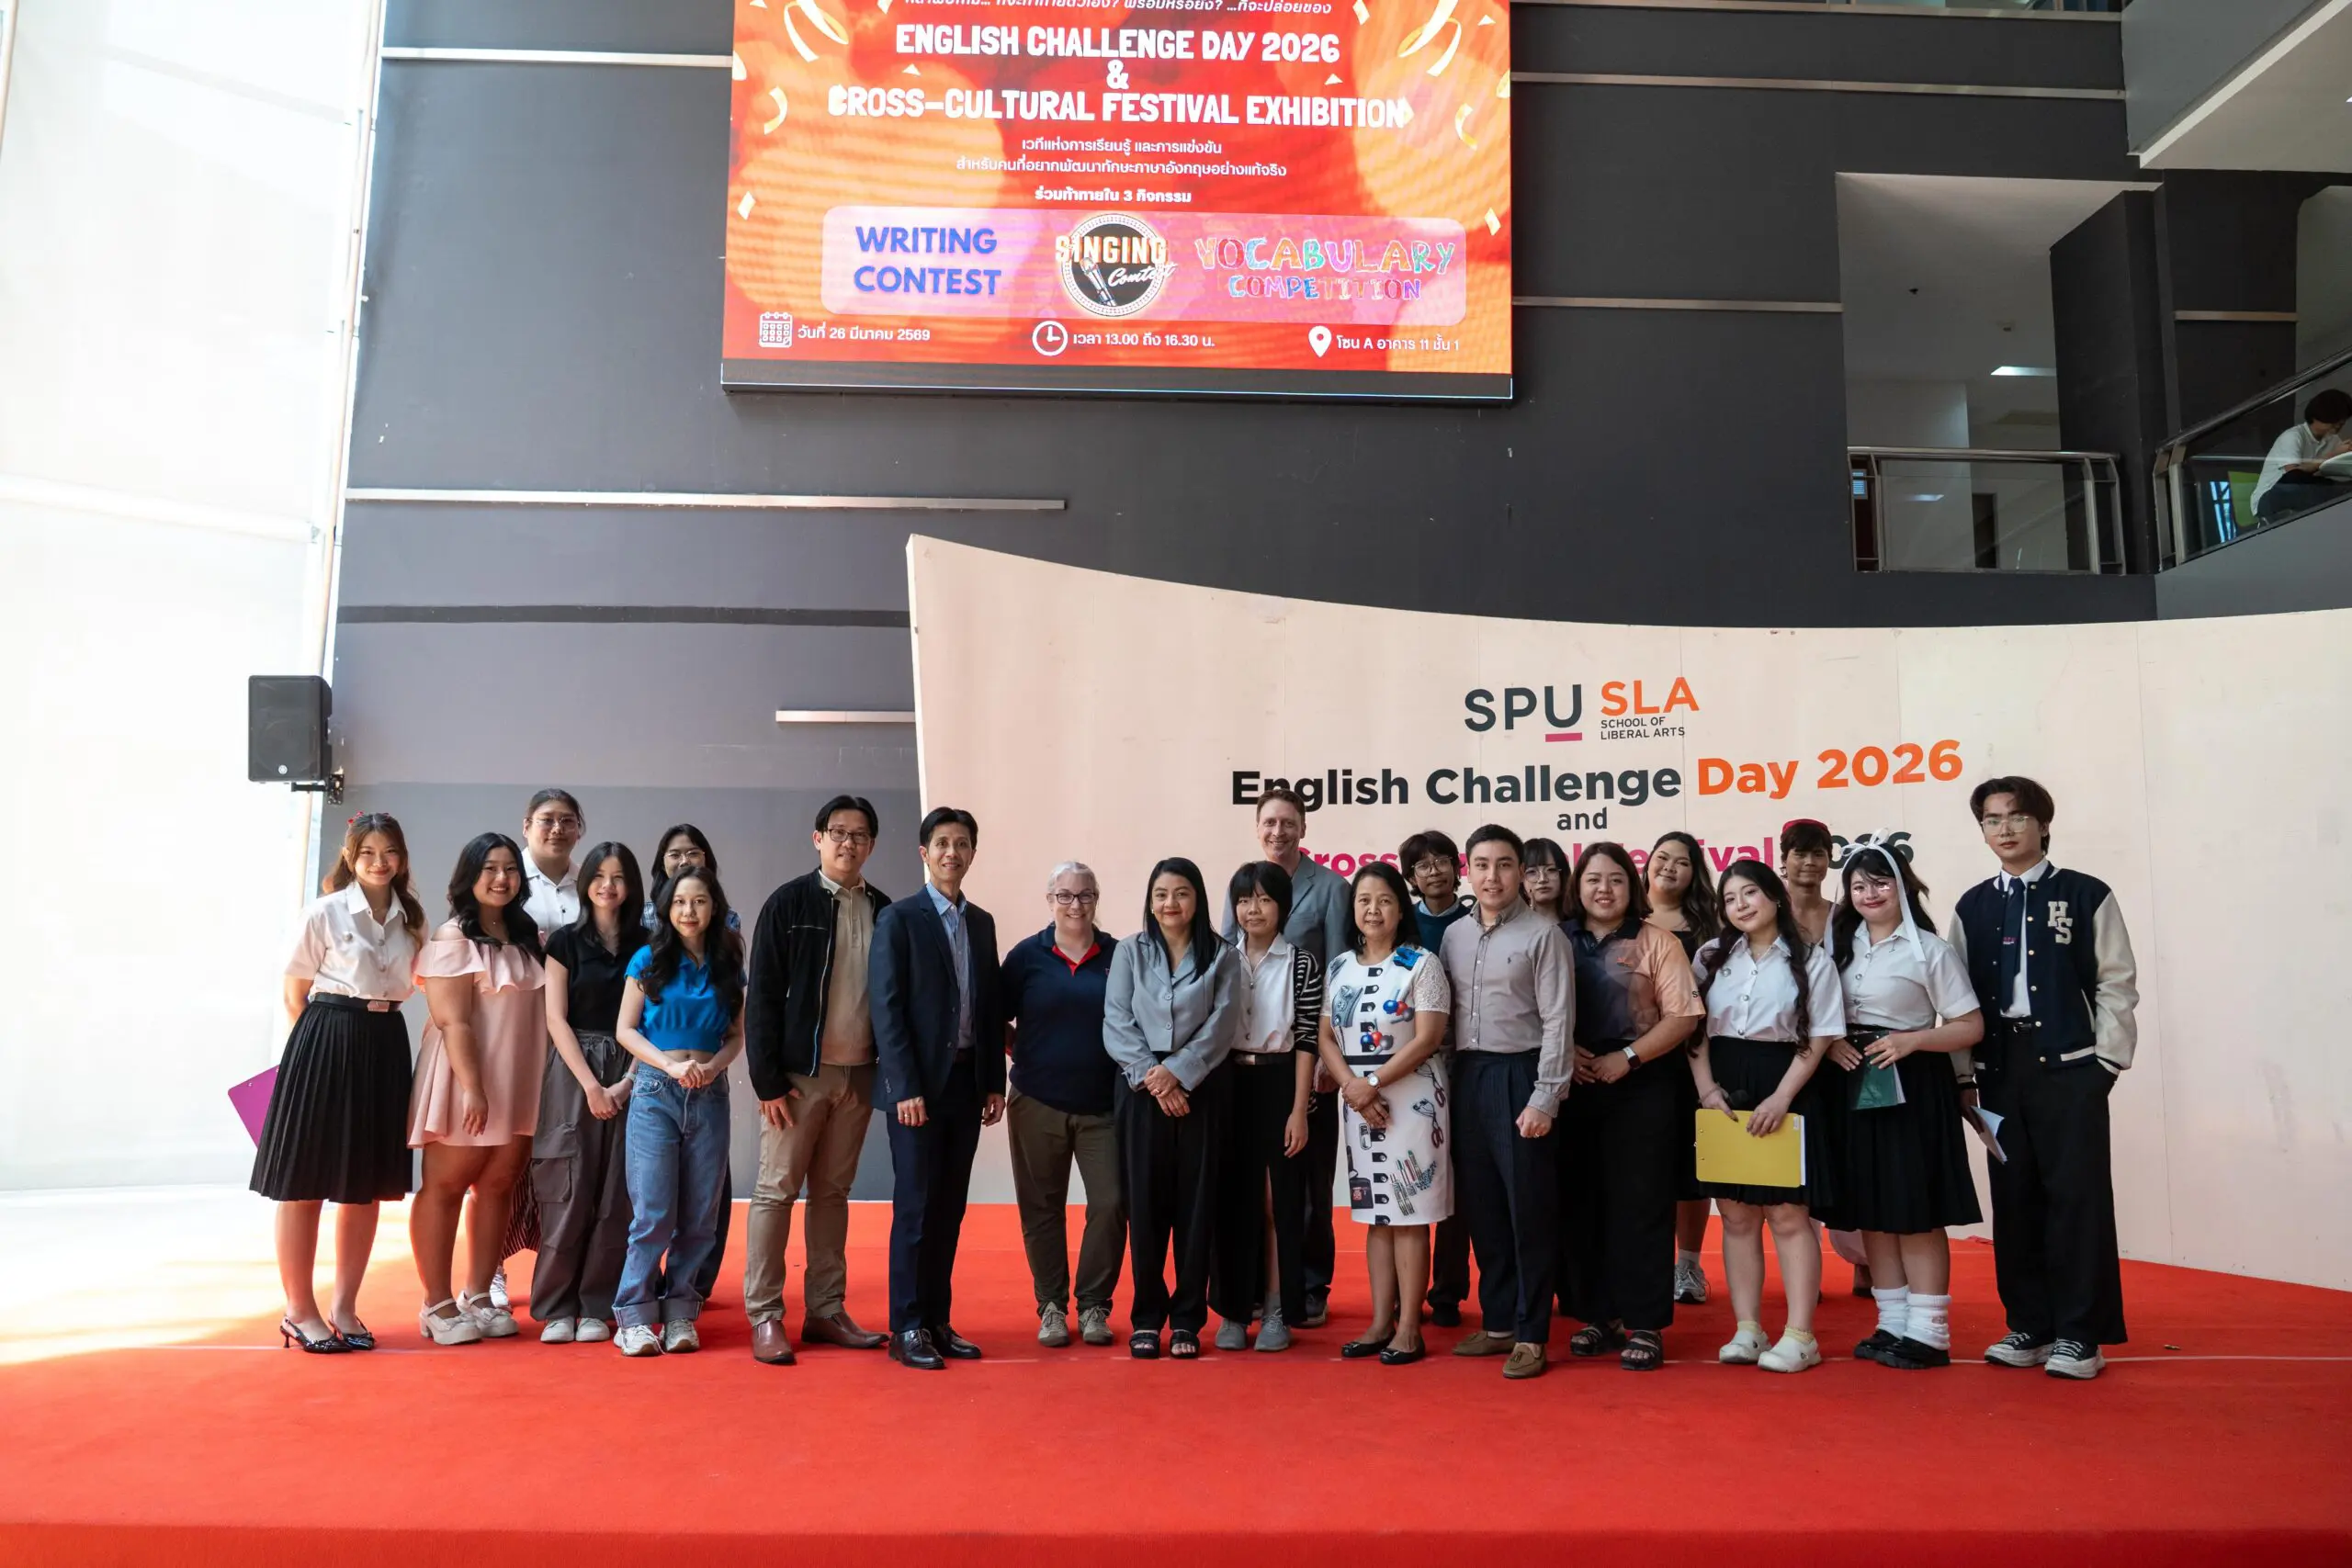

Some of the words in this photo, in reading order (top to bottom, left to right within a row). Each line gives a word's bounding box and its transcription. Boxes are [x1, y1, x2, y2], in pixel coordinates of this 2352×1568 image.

[897, 25, 1019, 55] ENGLISH
[1027, 26, 1194, 59] CHALLENGE
[1202, 31, 1256, 61] DAY
[1261, 33, 1340, 62] 2026
[1106, 60, 1129, 89] &
[829, 87, 1095, 121] CROSS-CULTURAL
[1102, 94, 1238, 124] FESTIVAL
[1247, 96, 1406, 128] EXHIBITION
[1124, 190, 1133, 202] 3
[1136, 188, 1192, 203] กิจกรรม
[855, 226, 997, 254] WRITING
[1056, 235, 1169, 265] SINGING
[1194, 237, 1455, 274] VOCABULARY
[854, 265, 1001, 296] CONTEST
[1228, 275, 1421, 300] COMPETITION
[797, 321, 826, 339] วันที่
[829, 327, 846, 339] 26
[849, 325, 893, 340] มีนาคม
[897, 329, 931, 341] 2569
[1073, 333, 1102, 344] เวลา
[1105, 333, 1139, 345] 13.00
[1143, 332, 1161, 346] ถึง
[1165, 334, 1198, 346] 16.30
[1202, 336, 1216, 347] น.
[1336, 334, 1360, 349] โซน
[1363, 337, 1374, 349] A
[1376, 339, 1416, 350] อาคาร
[1419, 339, 1429, 351] 11
[1433, 333, 1451, 351] ชั้น
[1454, 339, 1459, 350] 1
[1464, 684, 1582, 731] SPU
[1600, 677, 1700, 716] SLA
[1600, 717, 1647, 729] SCHOOL
[1650, 716, 1666, 727] OF
[1600, 728, 1650, 740] LIBERAL
[1653, 727, 1685, 738] ARTS
[1426, 764, 1681, 807] Challenge
[1698, 759, 1799, 800] Day
[1817, 739, 1963, 788] 2026
[1556, 807, 1608, 831] and
